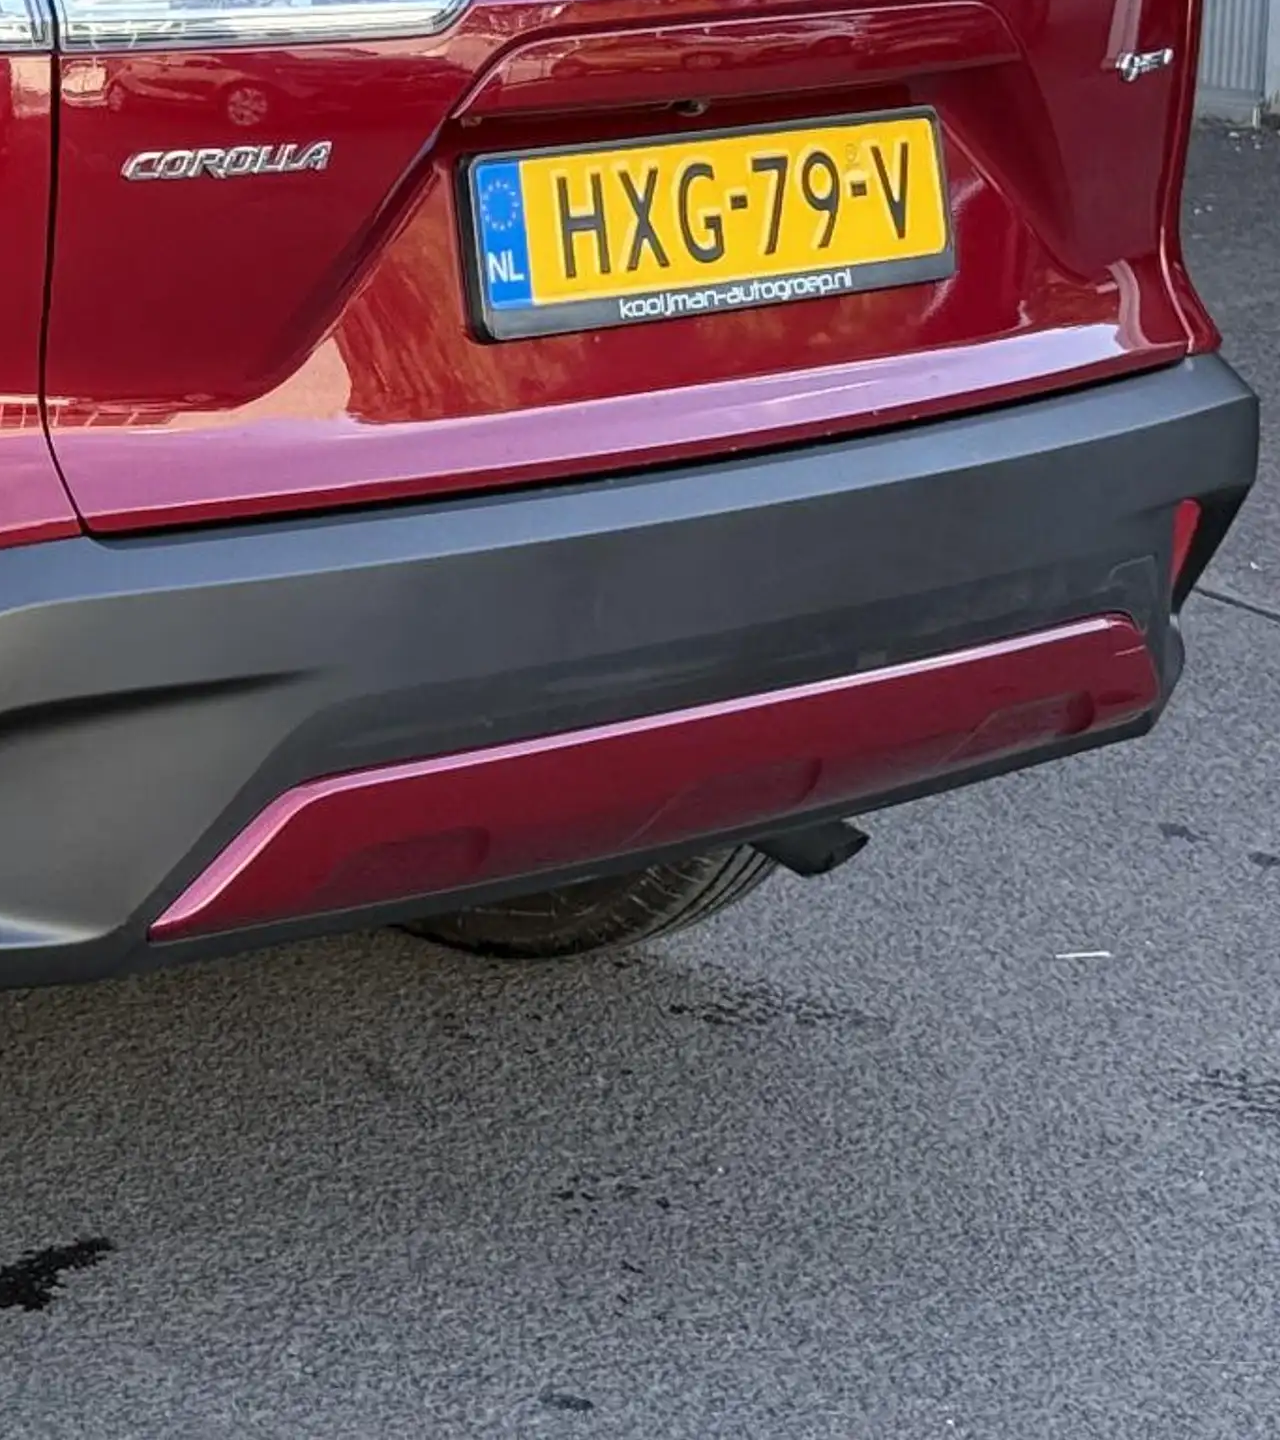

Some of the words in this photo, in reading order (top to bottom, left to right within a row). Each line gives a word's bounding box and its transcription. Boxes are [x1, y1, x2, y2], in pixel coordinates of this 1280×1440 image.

[120, 140, 333, 181] COROLLA
[555, 141, 910, 280] HXG-79-V
[487, 250, 525, 284] NL
[618, 267, 853, 321] kooijman-autogroep.nl
